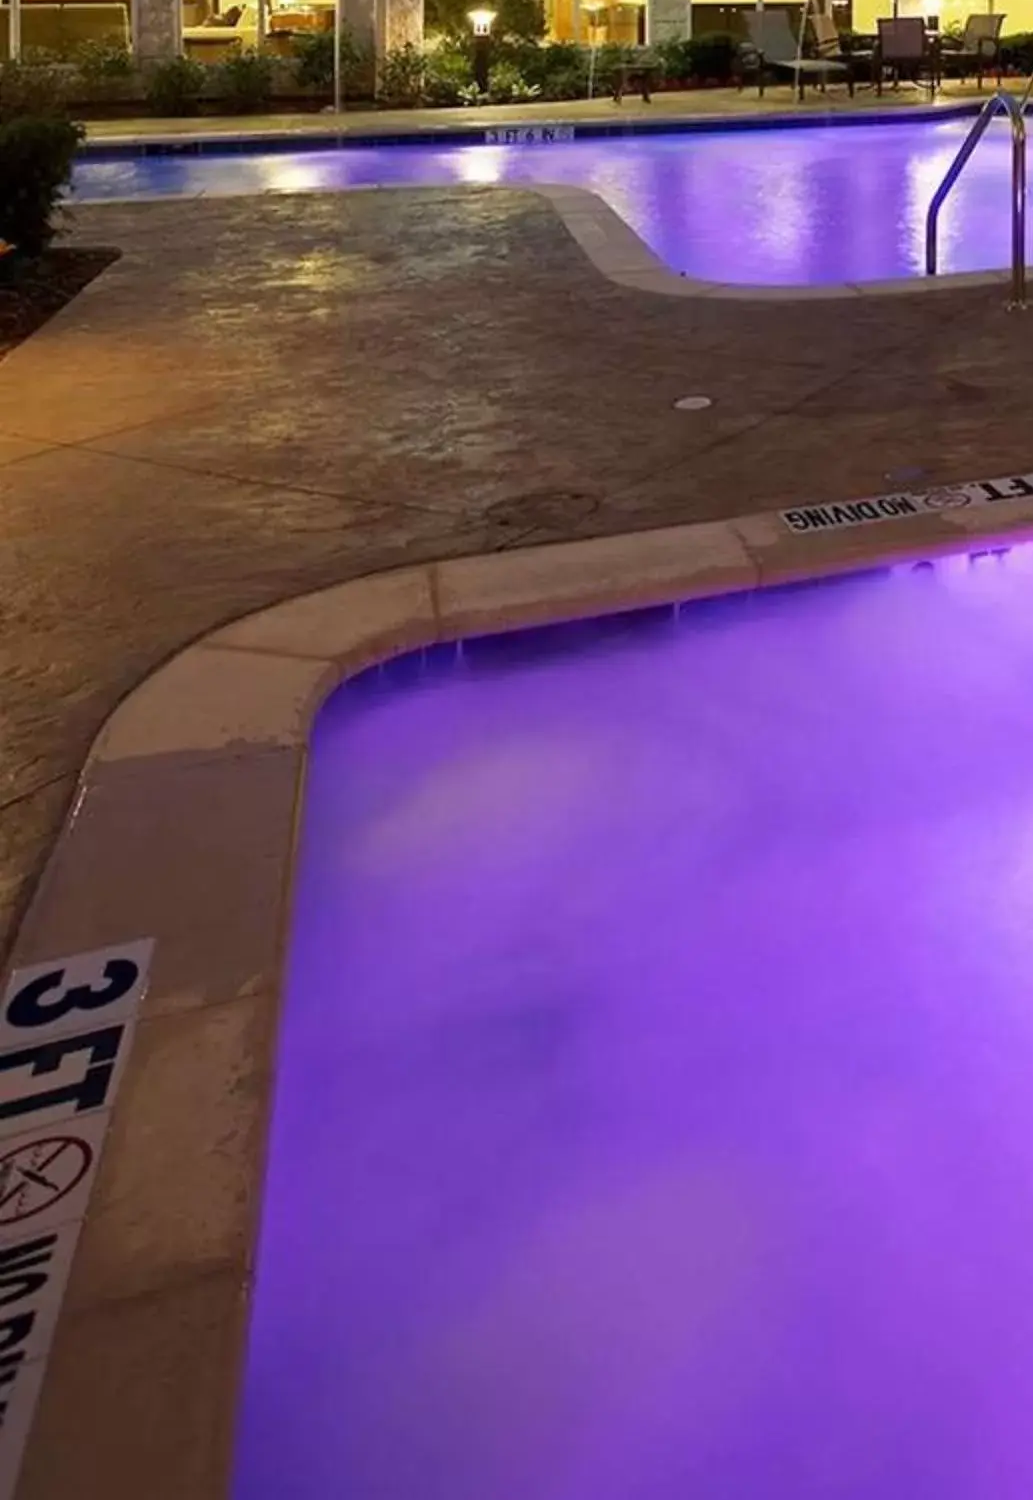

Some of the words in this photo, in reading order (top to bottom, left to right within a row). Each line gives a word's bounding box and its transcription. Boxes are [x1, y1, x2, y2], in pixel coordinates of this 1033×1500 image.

[784, 502, 876, 531] DIVING
[877, 495, 918, 516] NO
[6, 958, 139, 1028] 3
[0, 1023, 126, 1119] FT
